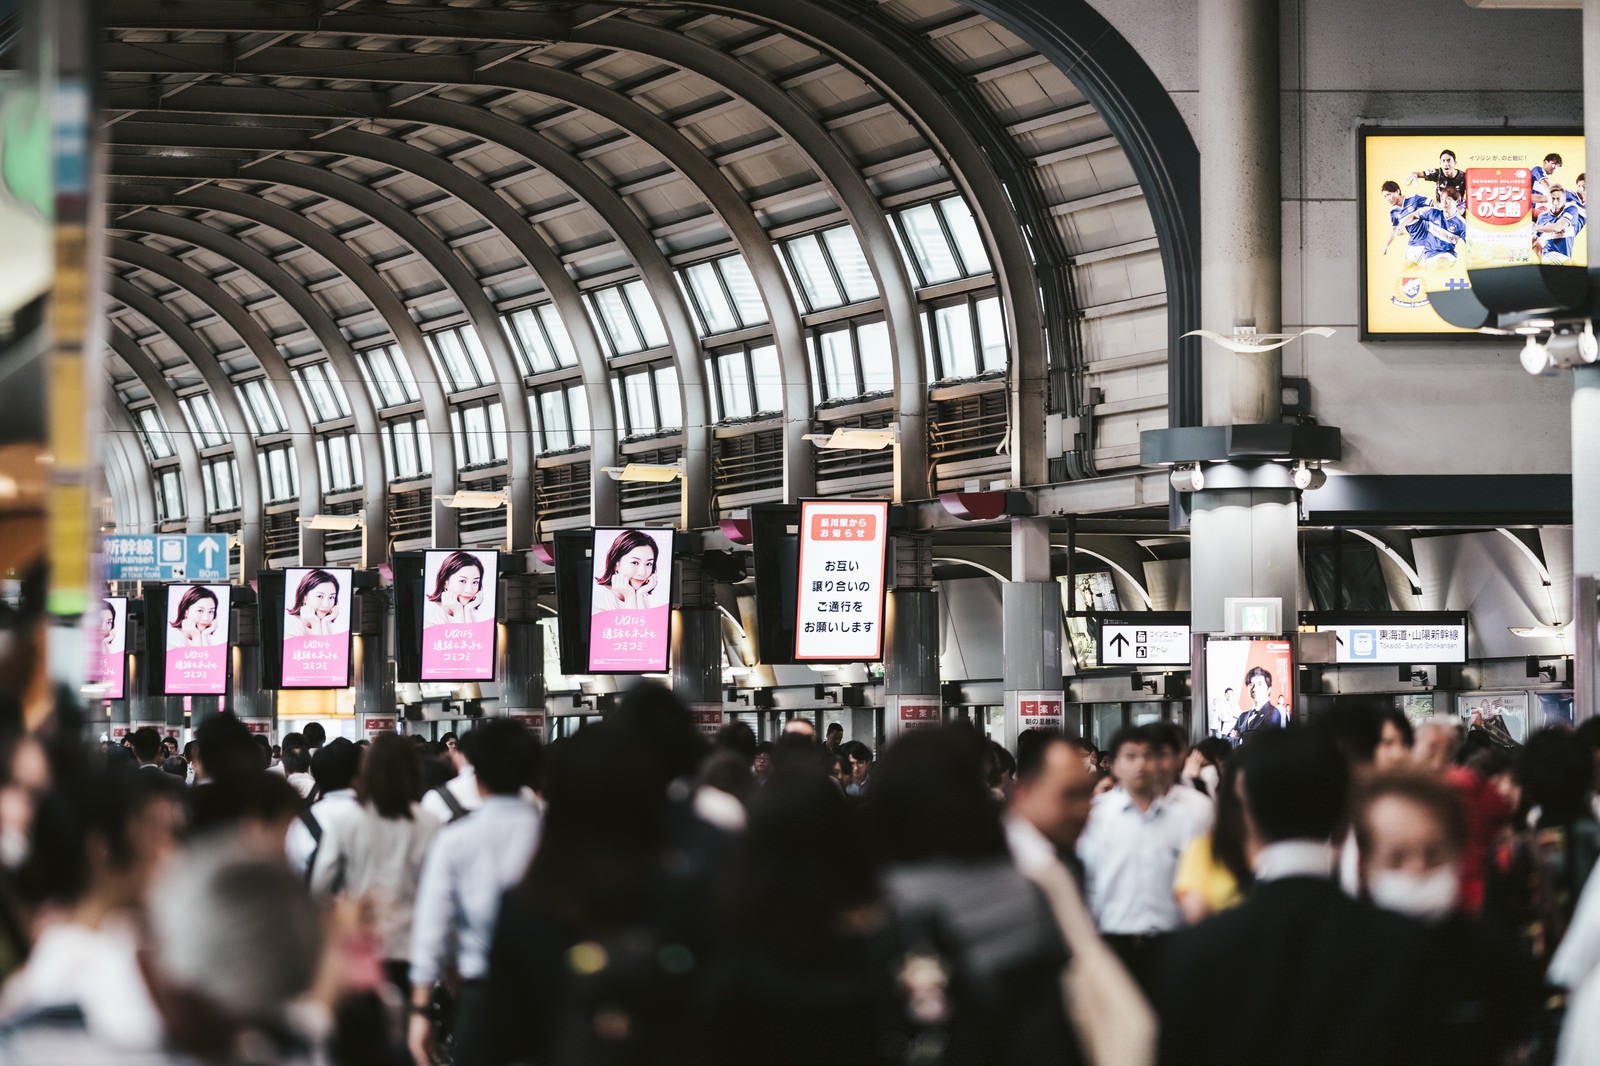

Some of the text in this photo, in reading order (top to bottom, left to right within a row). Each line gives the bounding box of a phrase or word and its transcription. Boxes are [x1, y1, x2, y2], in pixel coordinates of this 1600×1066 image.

[1477, 201, 1521, 217] のど飴
[820, 518, 867, 528] 品川駅から
[820, 529, 865, 537] お知らせ
[824, 560, 859, 572] お互い
[811, 580, 870, 592] 譲り合いの
[817, 601, 863, 613] ご通行を
[804, 621, 874, 633] お願いします
[1379, 629, 1459, 641] 東海道・山陽新幹線
[614, 642, 643, 651] コミコミ
[1025, 704, 1060, 714] ご案内
